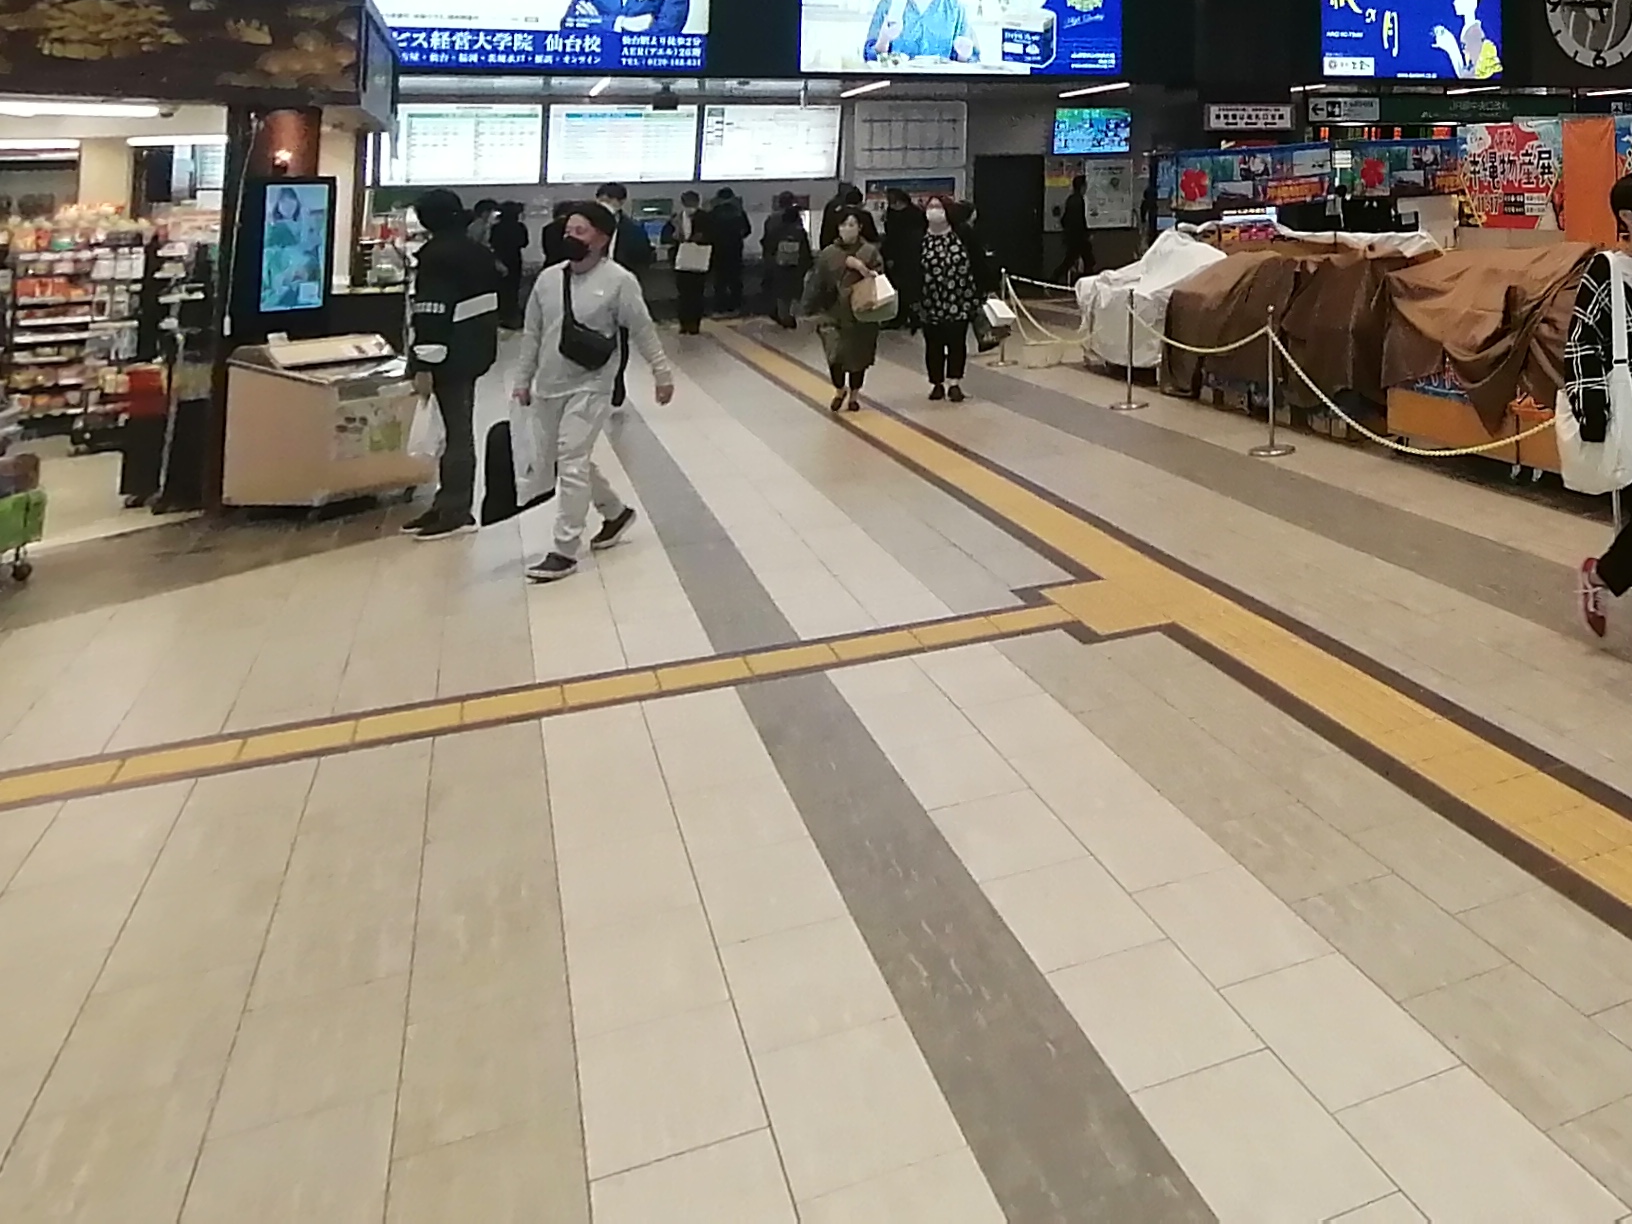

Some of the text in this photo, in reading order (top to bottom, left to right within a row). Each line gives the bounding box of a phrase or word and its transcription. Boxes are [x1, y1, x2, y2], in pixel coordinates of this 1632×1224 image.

[544, 33, 602, 53] 仙台校
[1463, 147, 1554, 190] 沖縄物産展
